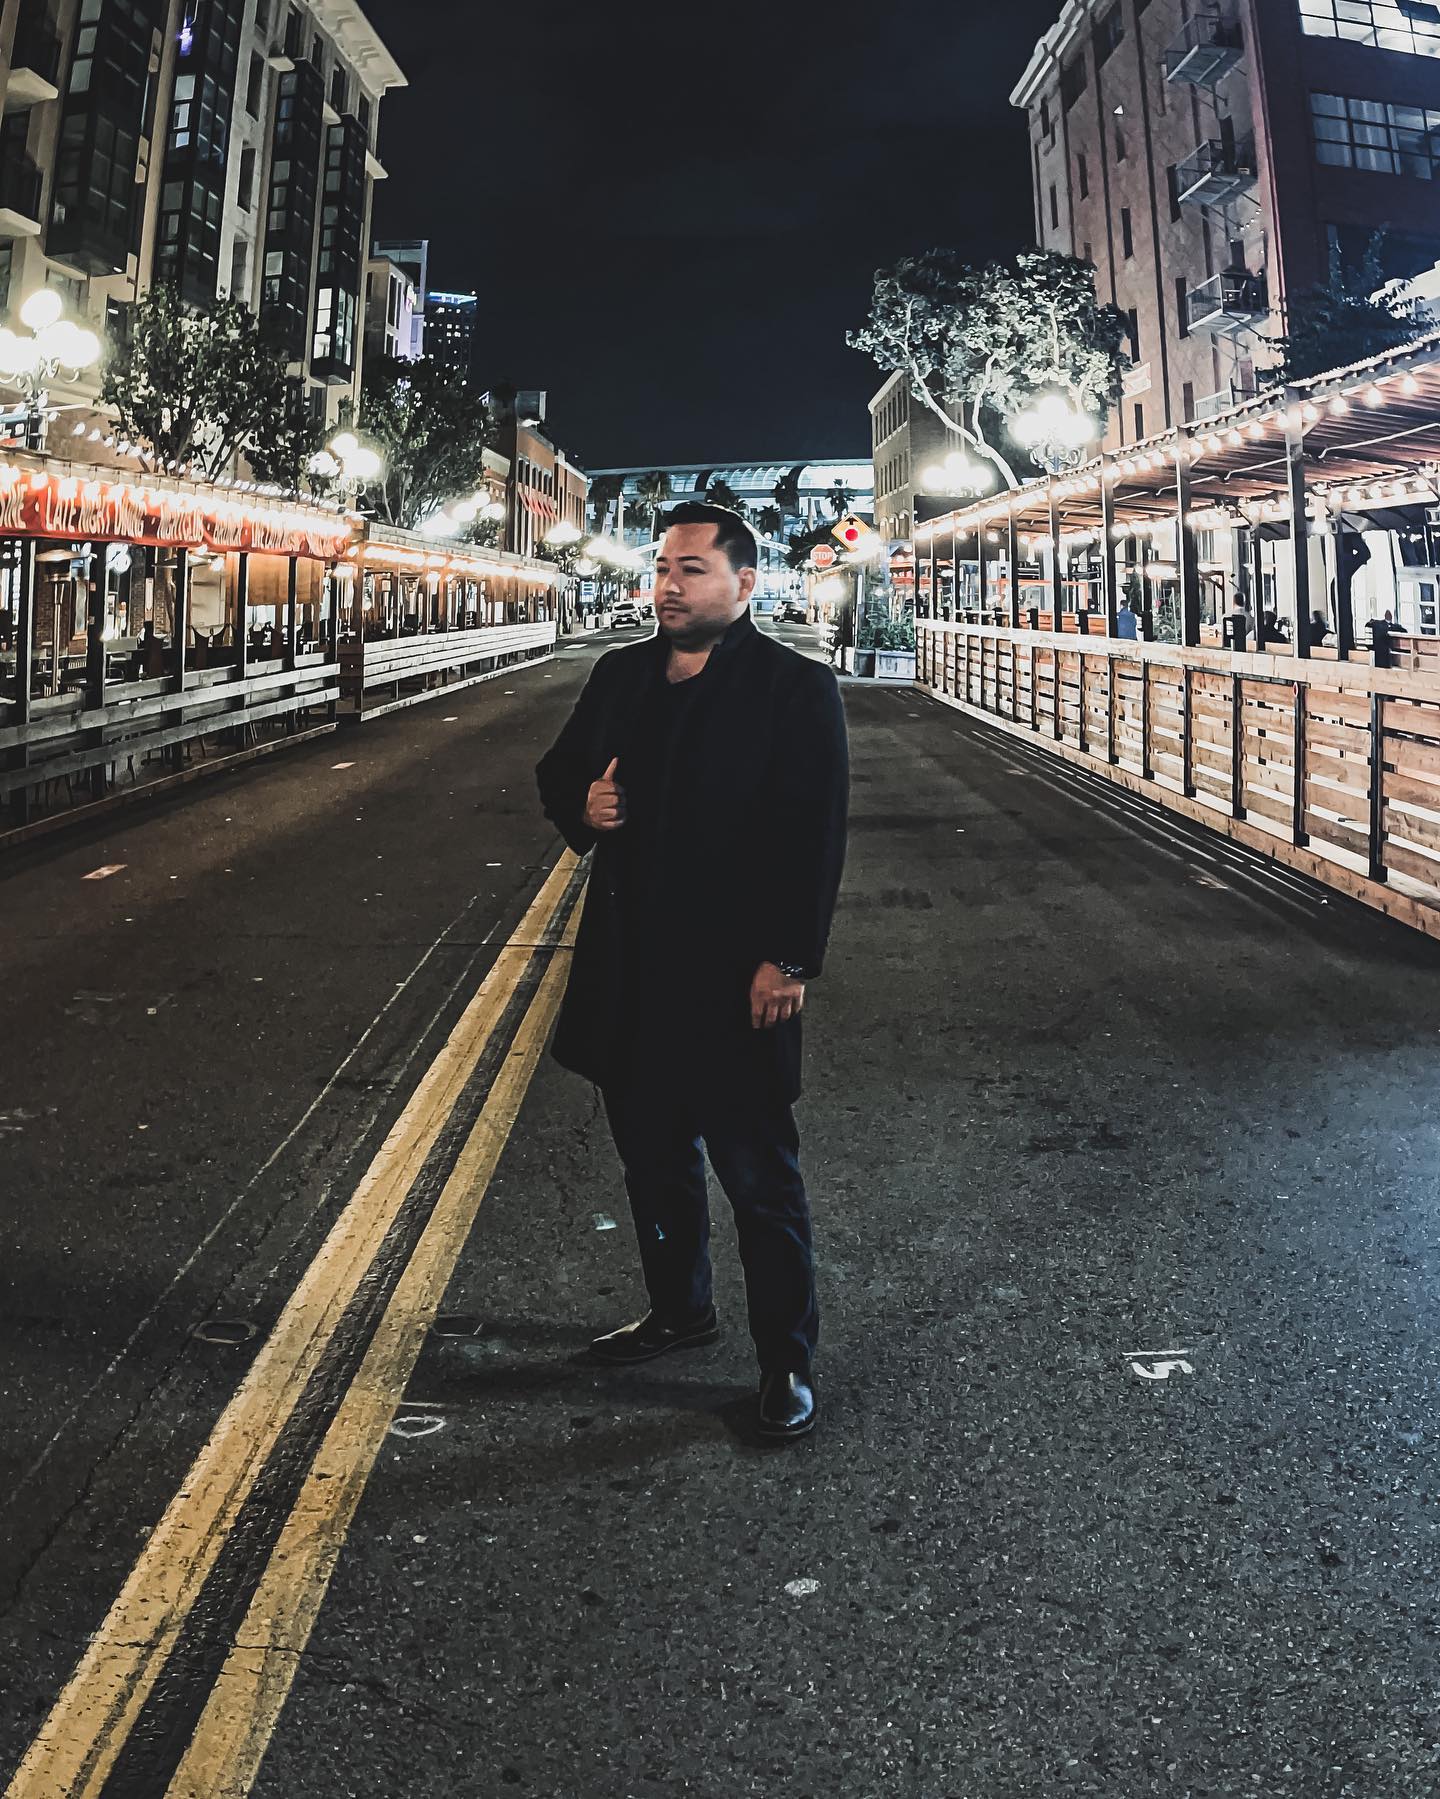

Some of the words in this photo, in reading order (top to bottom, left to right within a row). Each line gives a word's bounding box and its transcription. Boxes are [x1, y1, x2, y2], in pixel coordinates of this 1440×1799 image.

[46, 486, 75, 533] LATE
[78, 490, 110, 534] NIGHT
[813, 551, 832, 560] STOP
